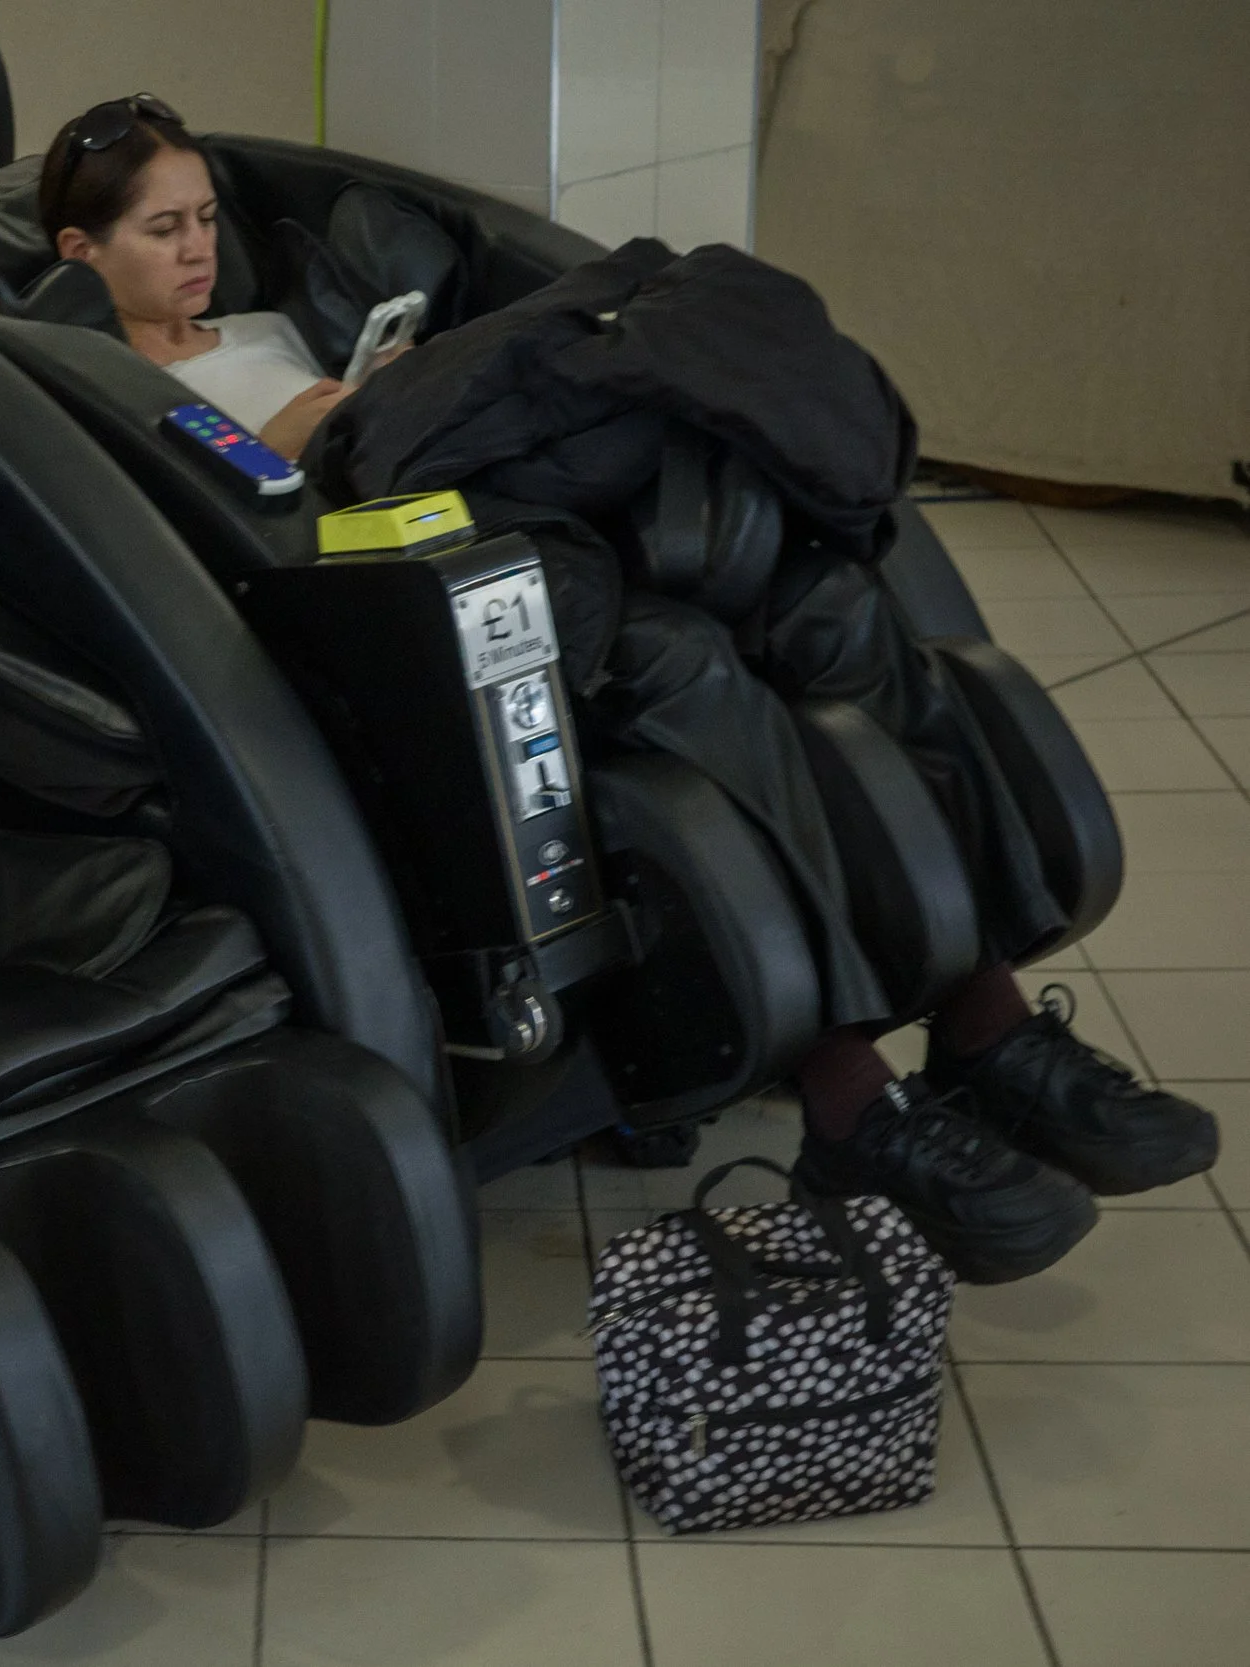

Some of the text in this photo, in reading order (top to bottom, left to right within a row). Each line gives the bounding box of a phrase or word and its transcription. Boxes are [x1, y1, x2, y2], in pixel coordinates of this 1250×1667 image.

[481, 591, 531, 643] £1
[477, 636, 544, 670] 5 Minutes
